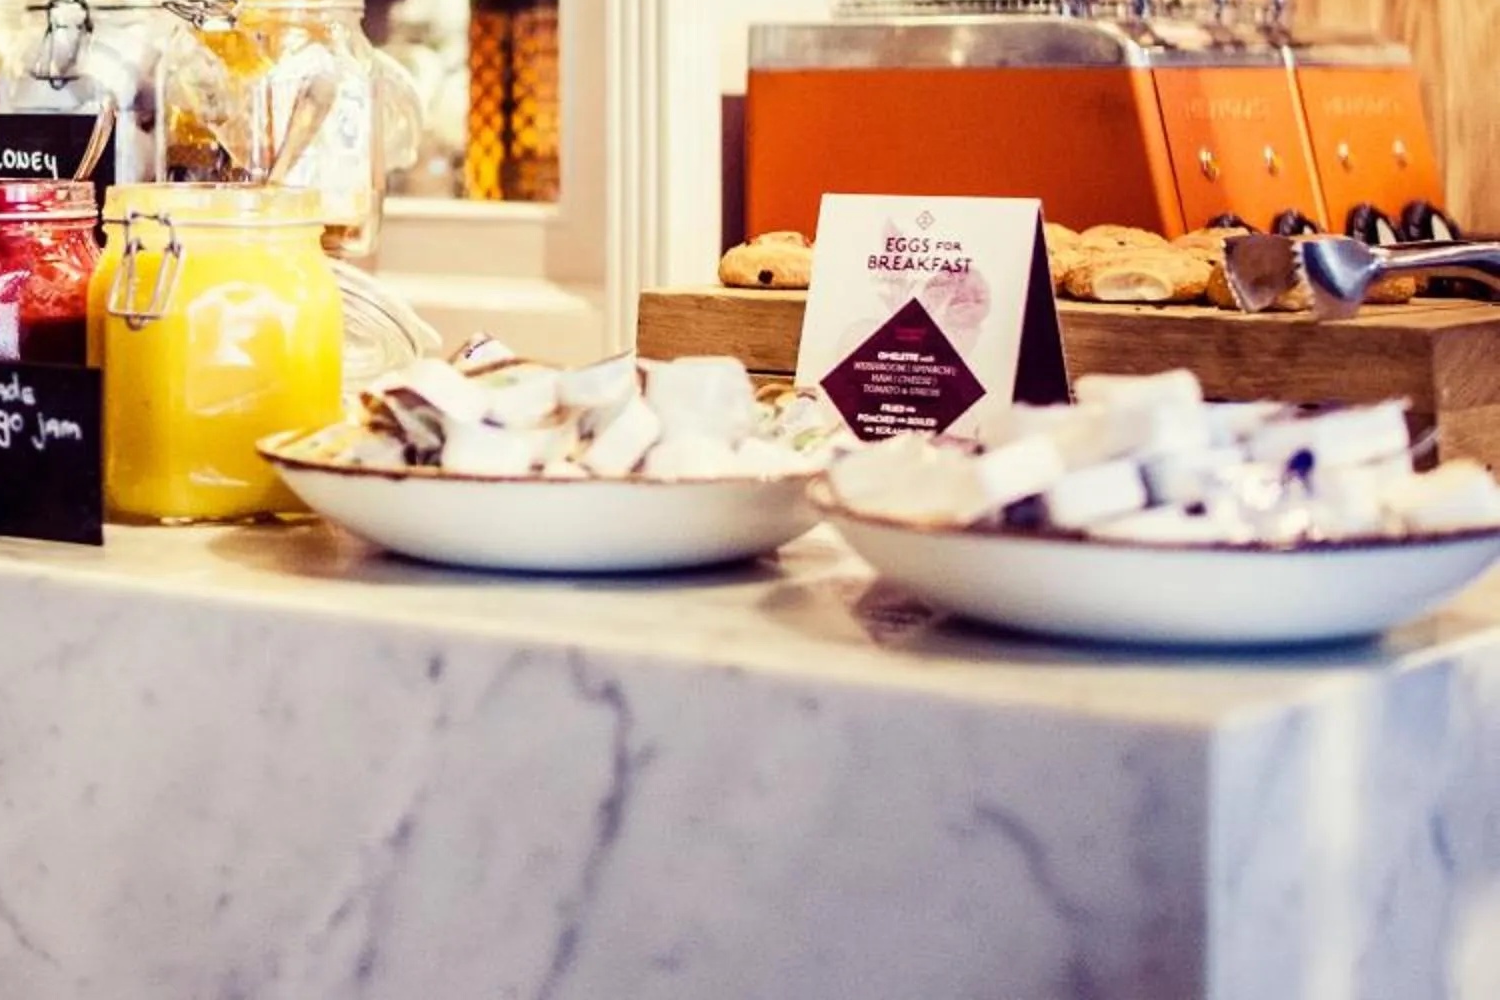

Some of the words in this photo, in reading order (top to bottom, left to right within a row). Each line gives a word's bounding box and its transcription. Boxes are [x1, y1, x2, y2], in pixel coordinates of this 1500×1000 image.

[884, 236, 930, 253] EGGS
[935, 240, 963, 252] FOR
[867, 255, 973, 275] BREAKFAST
